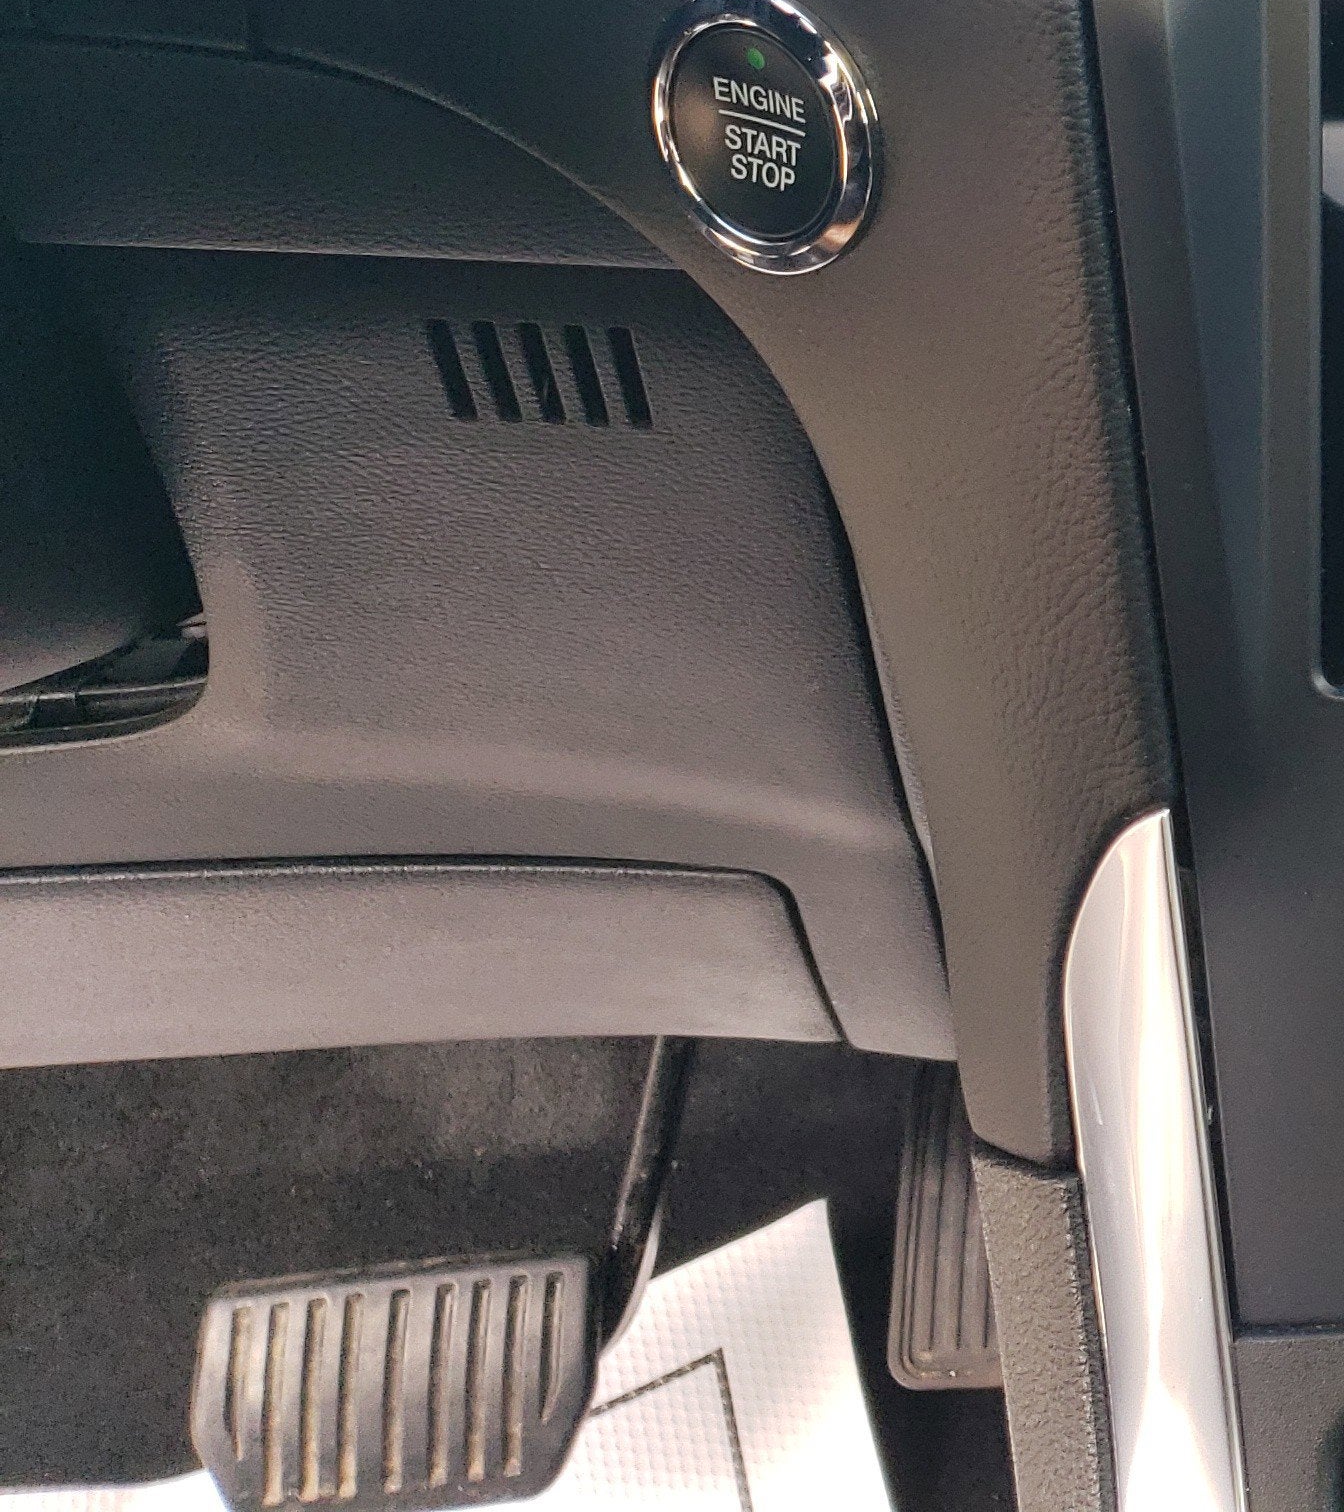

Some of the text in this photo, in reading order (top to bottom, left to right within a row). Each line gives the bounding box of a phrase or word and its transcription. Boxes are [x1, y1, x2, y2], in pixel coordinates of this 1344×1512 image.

[712, 76, 806, 124] ENGINE
[724, 124, 802, 167] START
[730, 153, 796, 192] STOP
